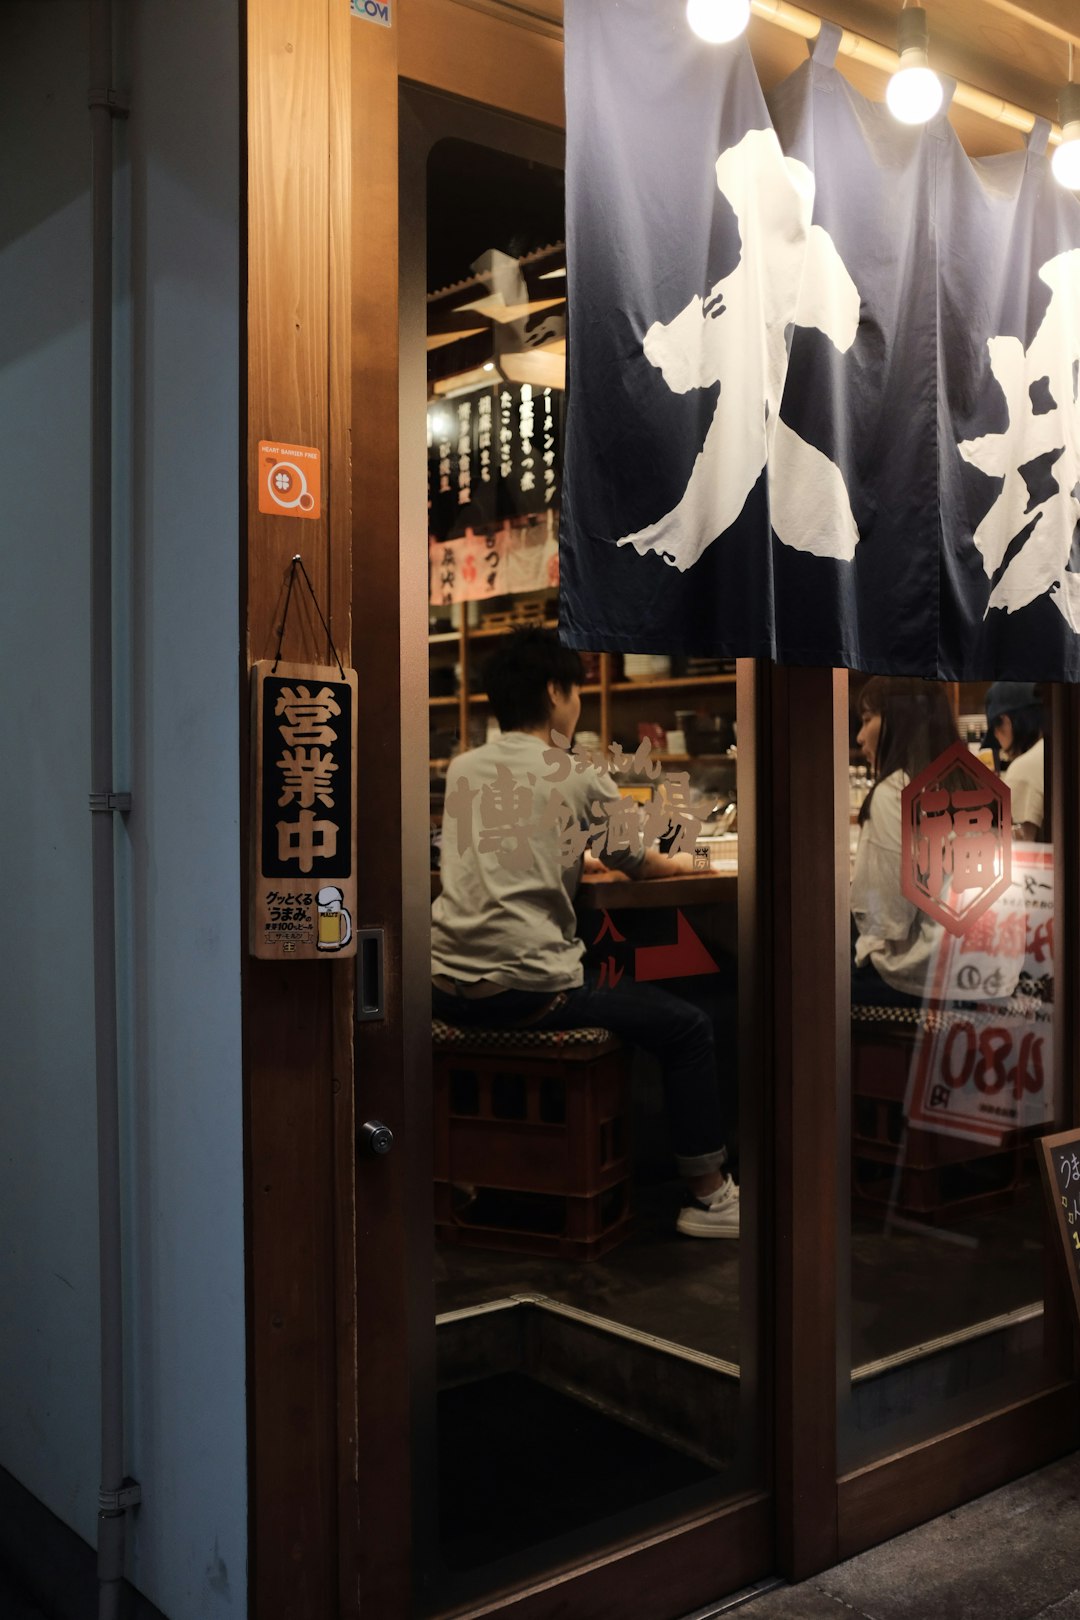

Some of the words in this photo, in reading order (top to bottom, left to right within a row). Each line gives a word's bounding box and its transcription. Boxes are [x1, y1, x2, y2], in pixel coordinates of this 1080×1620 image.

[350, 0, 388, 21] COM
[262, 446, 279, 454] HEART
[280, 449, 303, 458] BARRIER
[304, 452, 318, 460] FREE
[274, 685, 341, 873] 営業中
[446, 764, 716, 871] 博多酒場
[266, 891, 312, 905] グッとくる
[283, 942, 296, 952] 生
